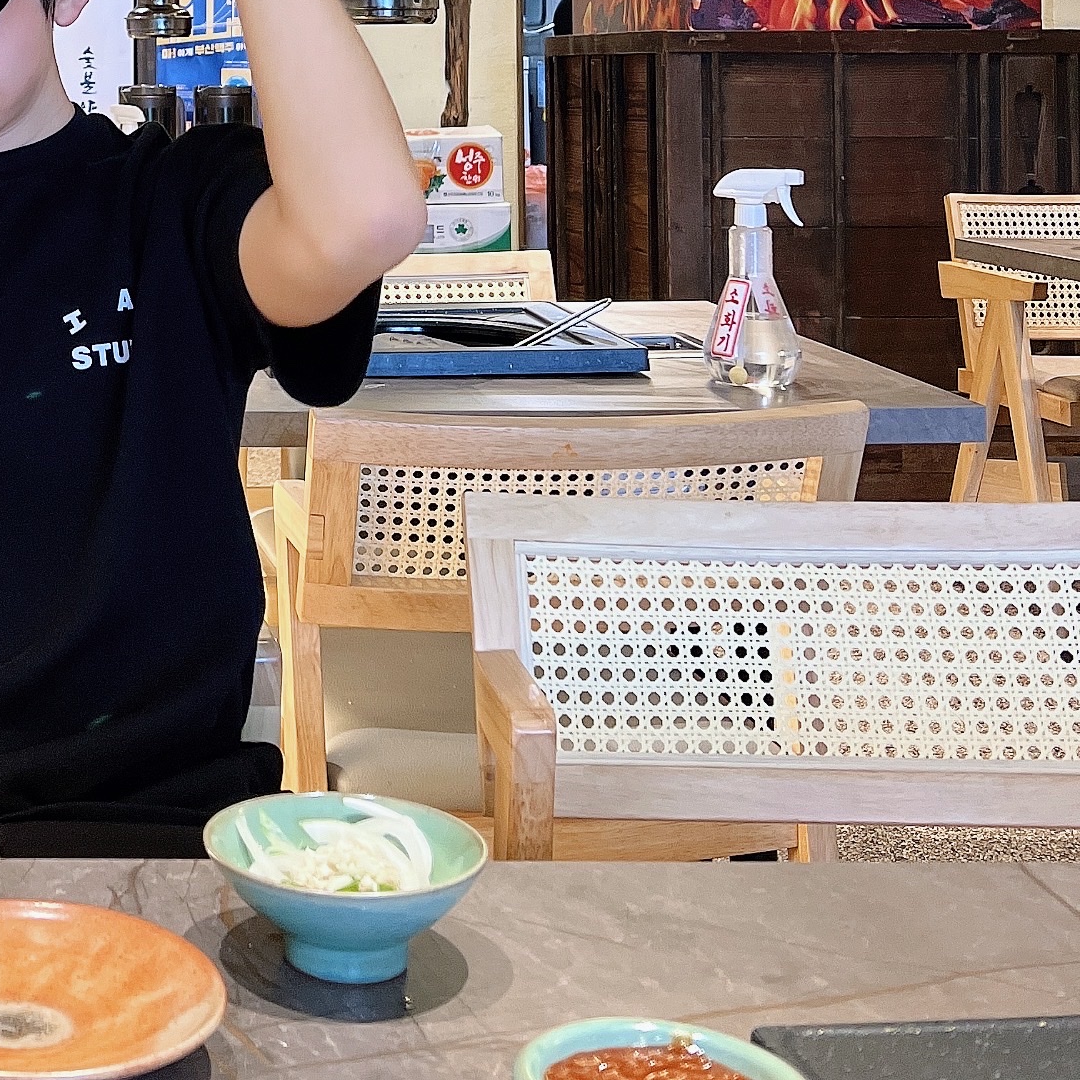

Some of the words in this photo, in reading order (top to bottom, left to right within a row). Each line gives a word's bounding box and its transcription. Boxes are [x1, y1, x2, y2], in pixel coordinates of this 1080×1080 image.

[454, 147, 486, 174] 성주
[62, 308, 88, 336] I
[716, 288, 740, 352] 소화기
[71, 339, 133, 371] STU
